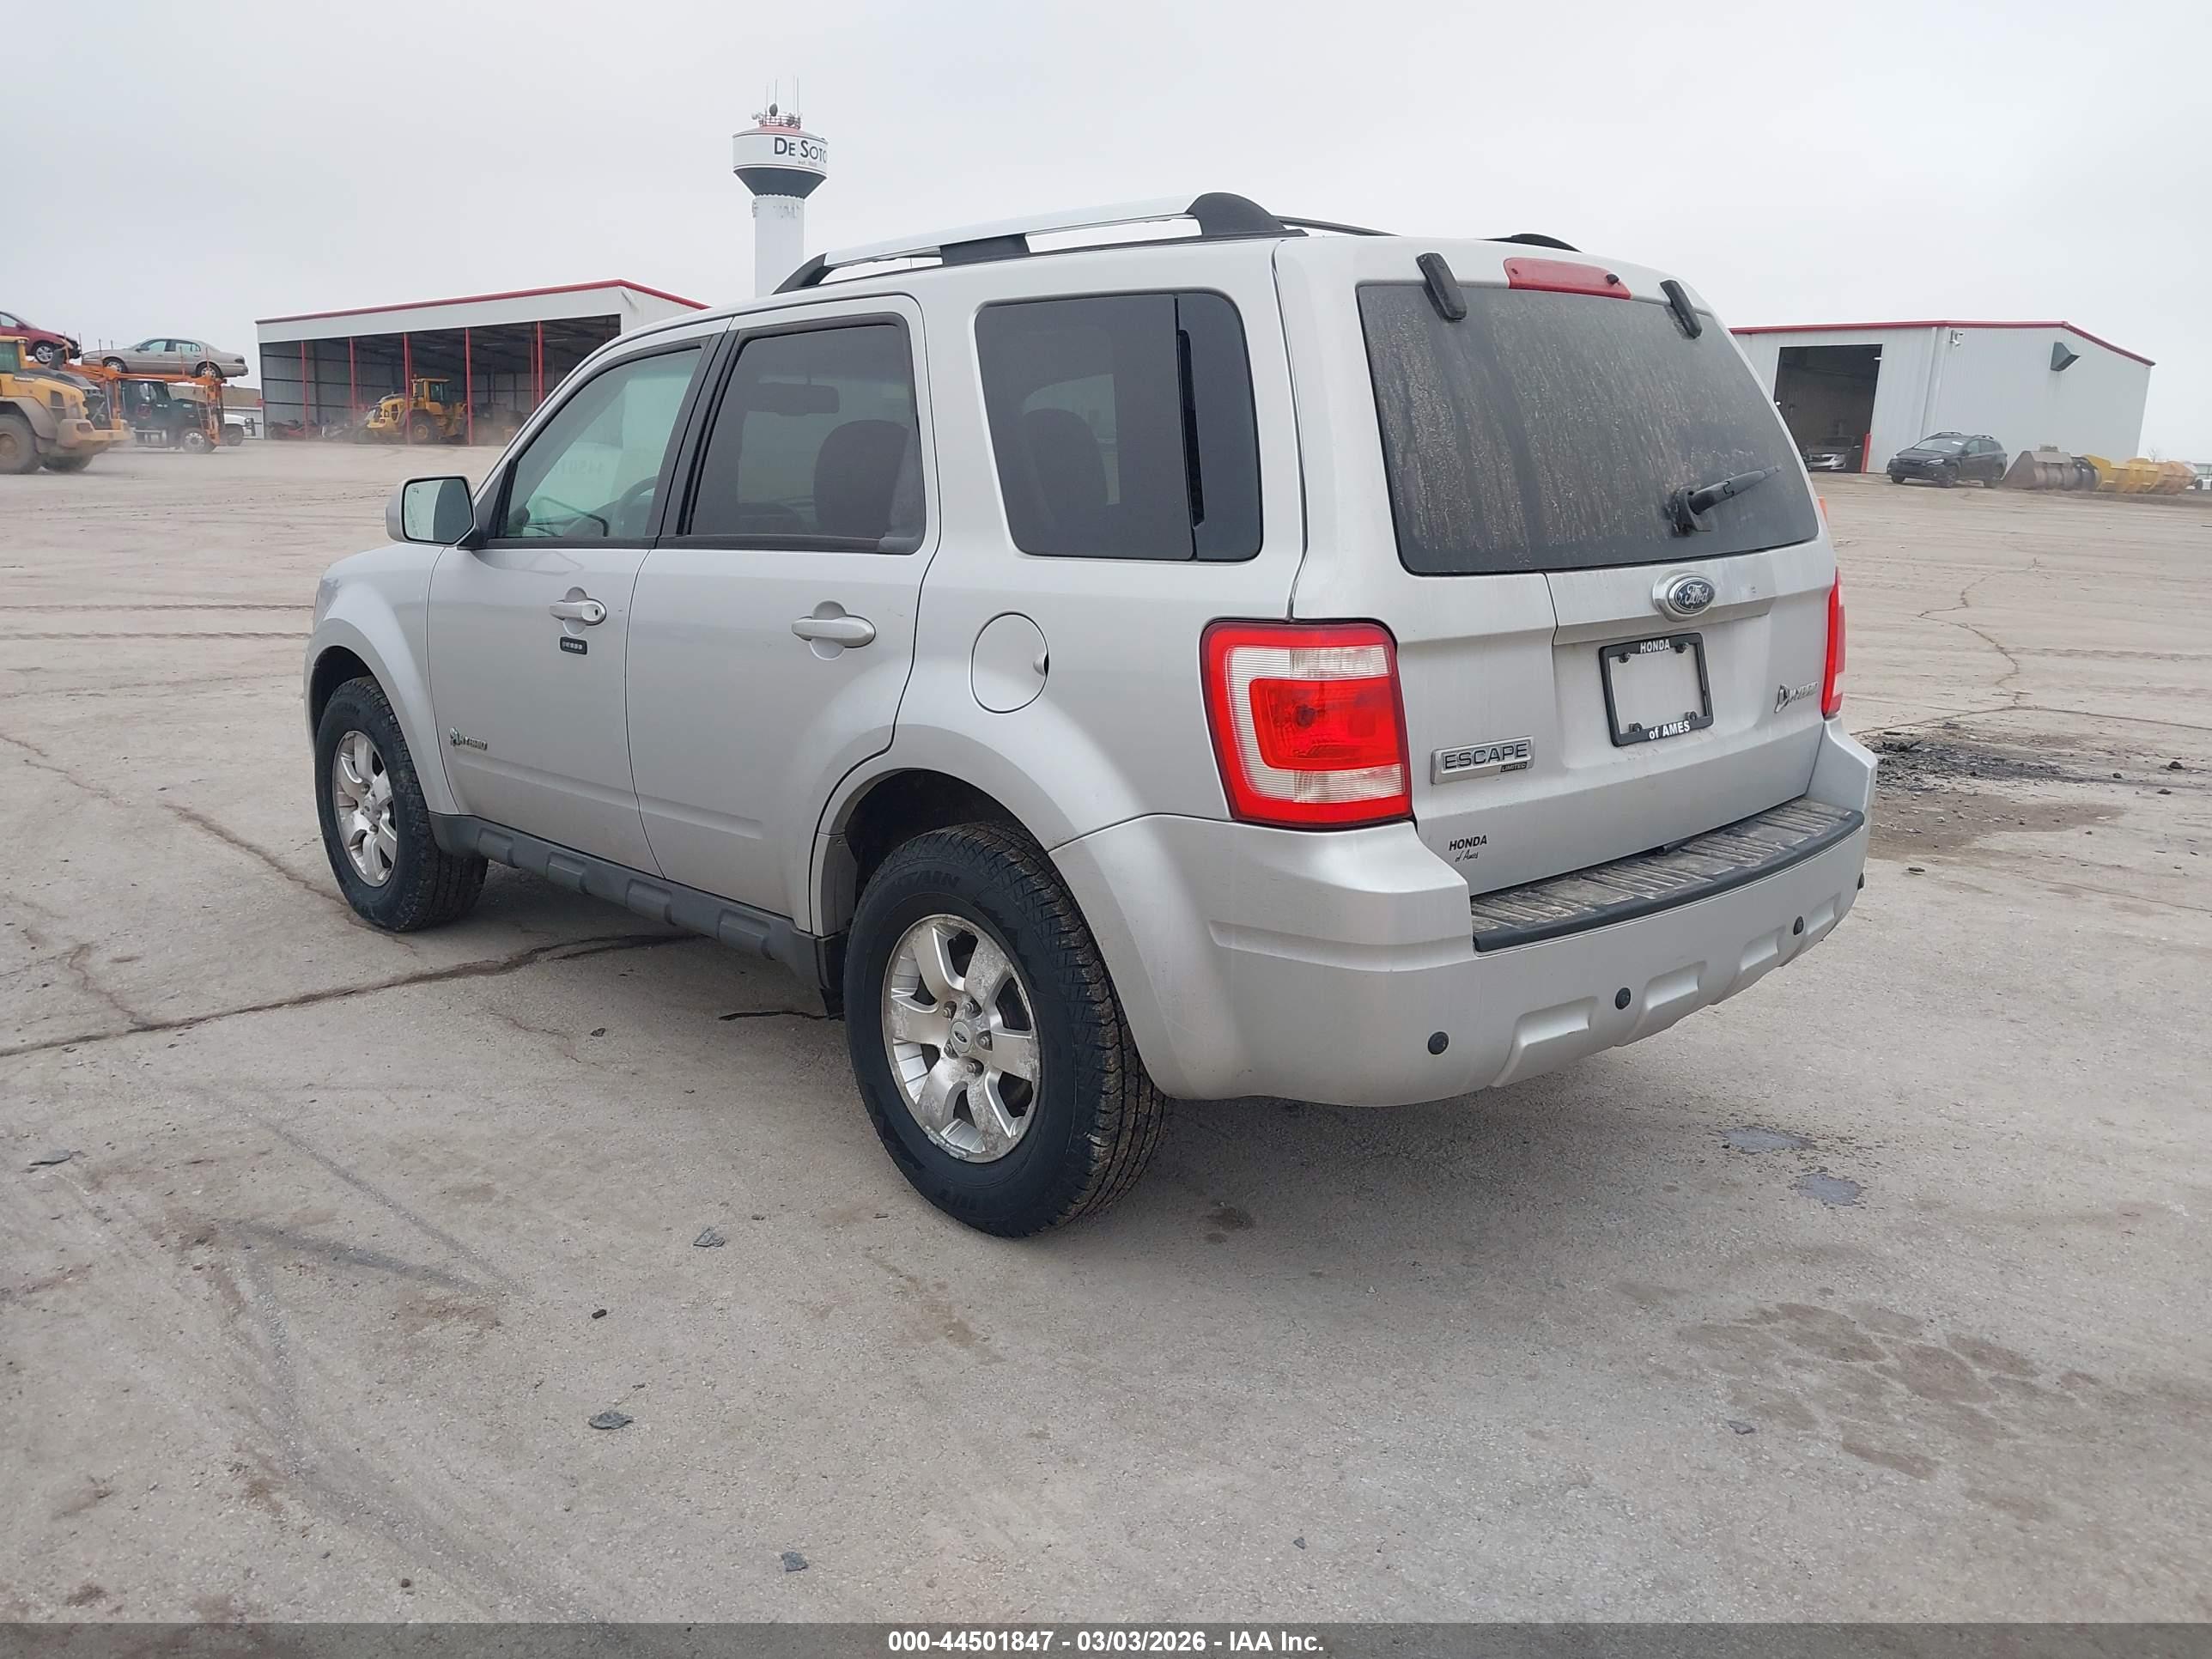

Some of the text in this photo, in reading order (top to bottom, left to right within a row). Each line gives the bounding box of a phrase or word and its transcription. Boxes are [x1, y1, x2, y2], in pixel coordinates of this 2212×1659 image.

[1684, 584, 1710, 605] Ford
[1640, 639, 1671, 654] HONDA
[1649, 720, 1691, 740] of AMES
[1444, 743, 1528, 769] ESCAPE
[1449, 835, 1487, 851] HONDA
